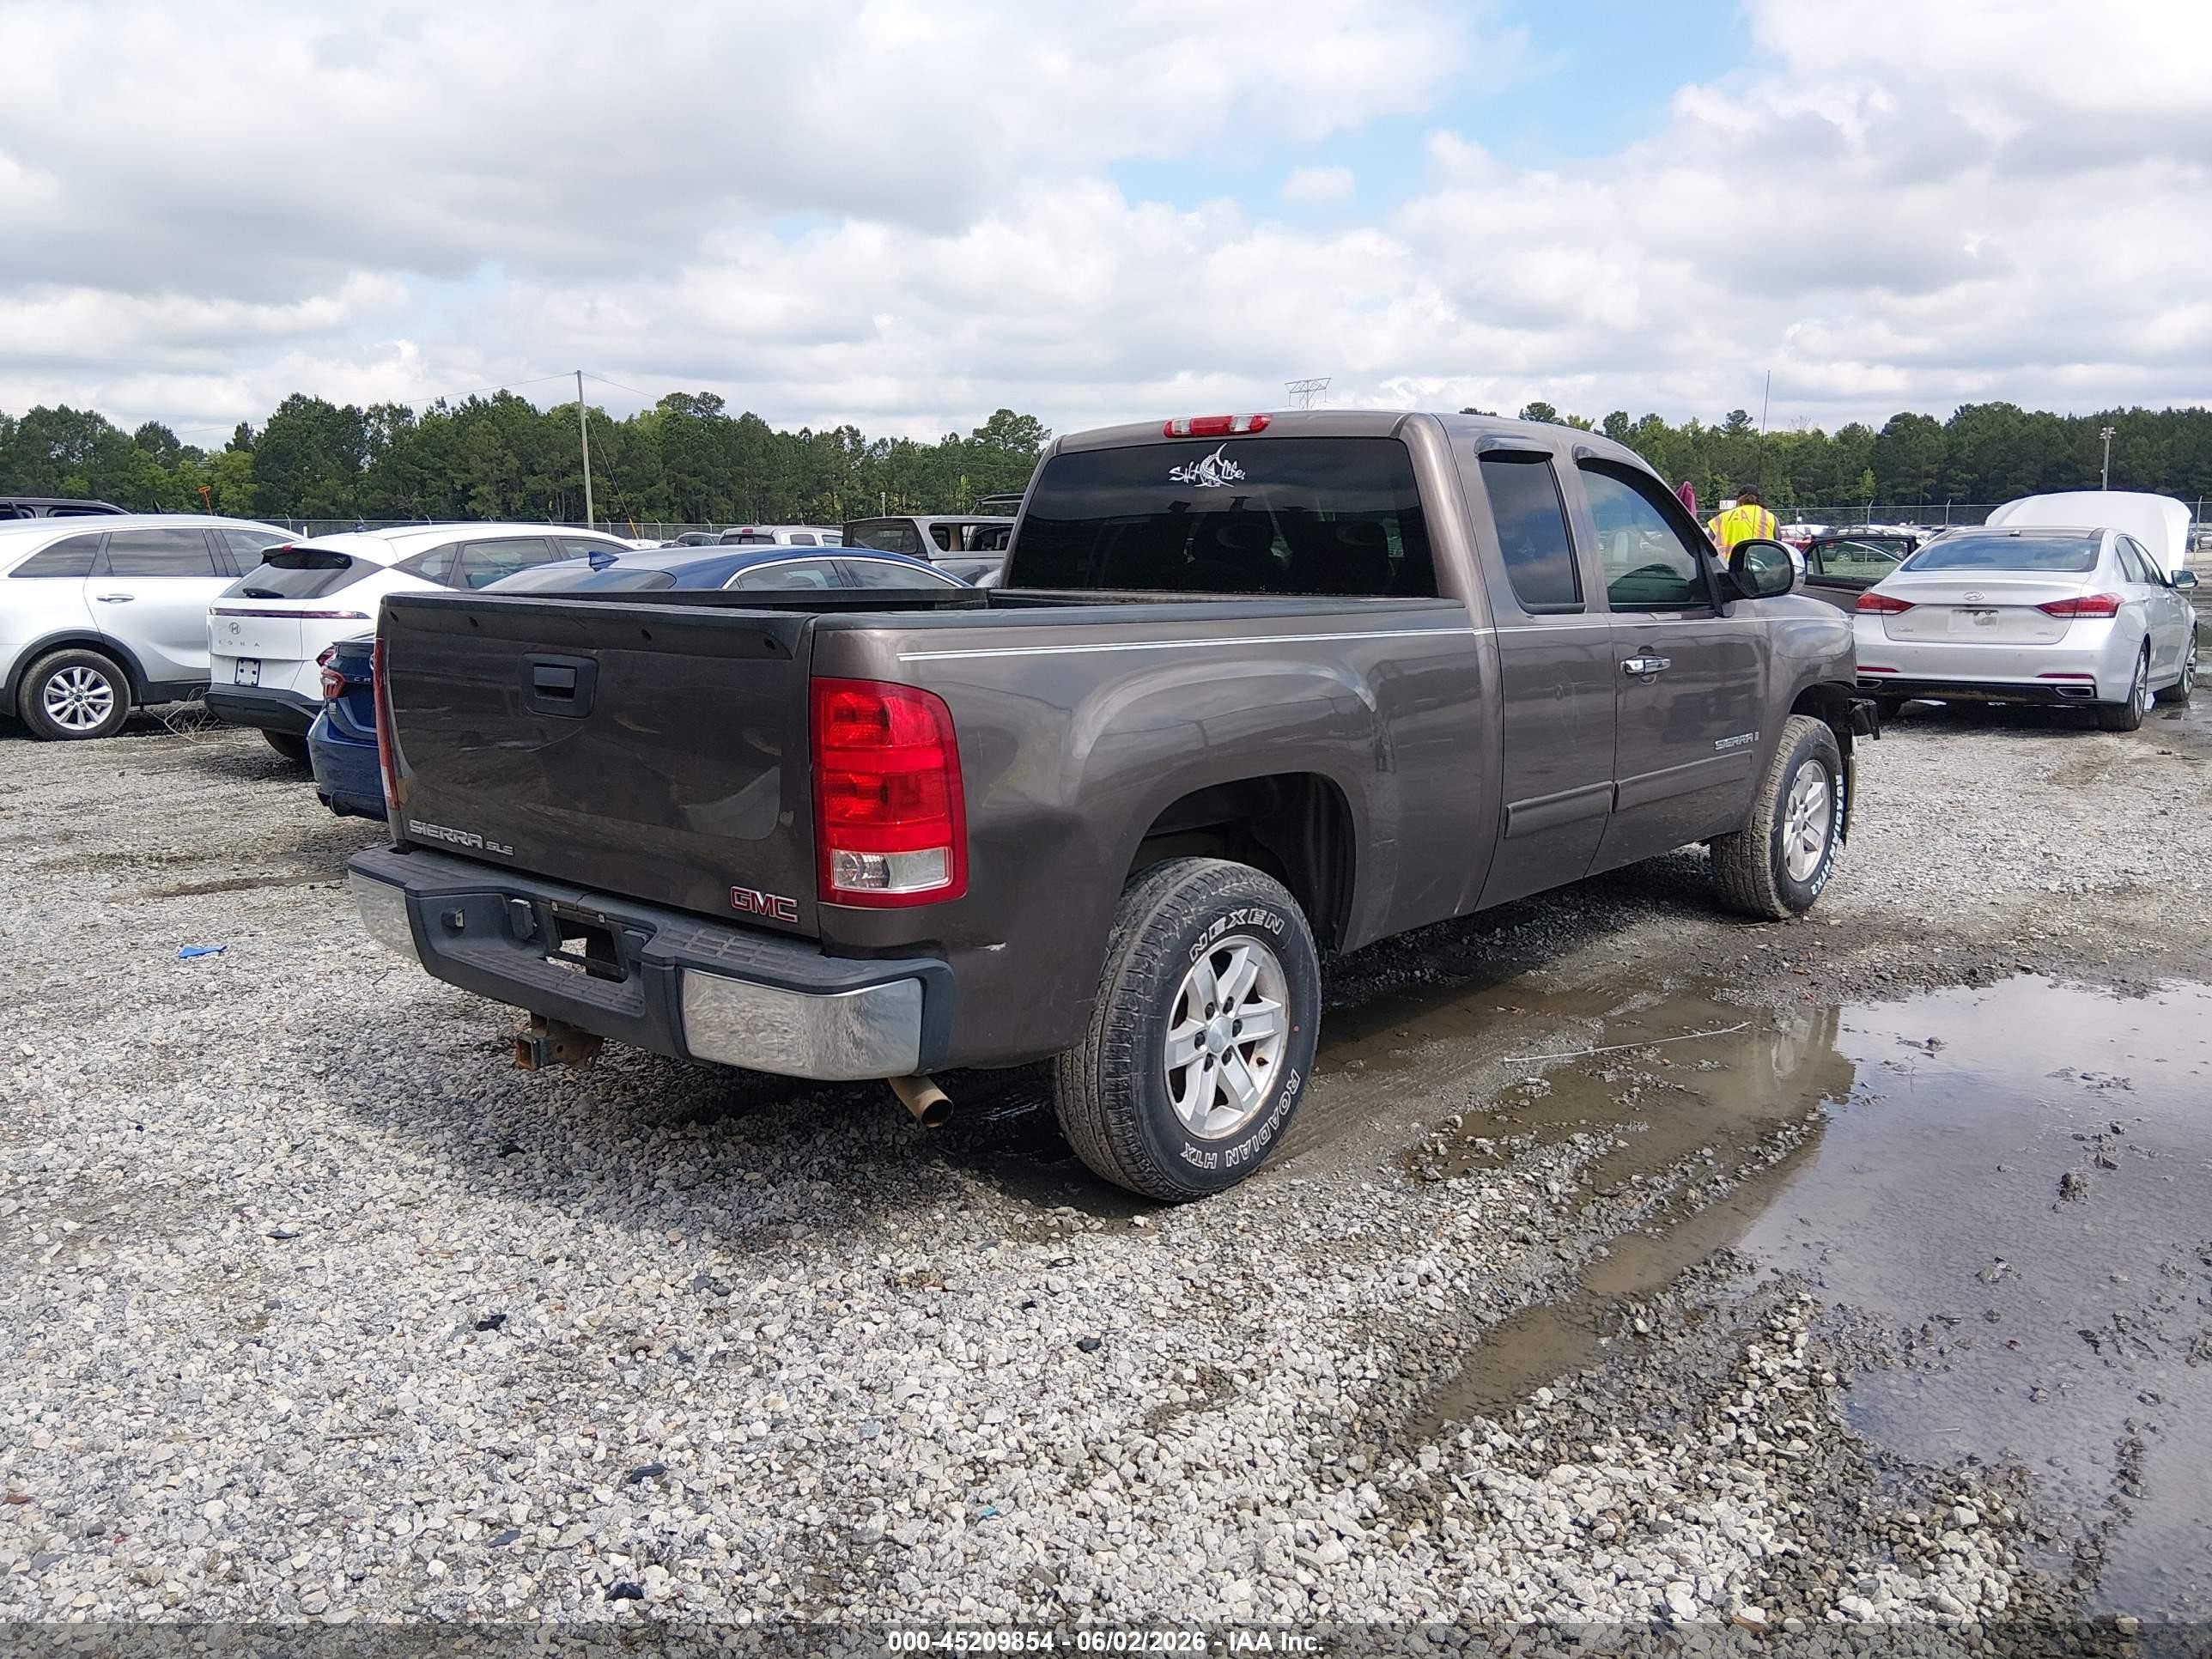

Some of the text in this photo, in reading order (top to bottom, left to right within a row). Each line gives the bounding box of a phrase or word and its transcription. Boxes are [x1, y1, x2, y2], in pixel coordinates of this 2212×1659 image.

[1714, 732, 1753, 750] SIERRA
[410, 819, 514, 856] SIERRA SLE
[730, 885, 798, 923] GMC
[1188, 908, 1285, 963] NEXEN
[1180, 1068, 1301, 1170] ROADIAN HTX
